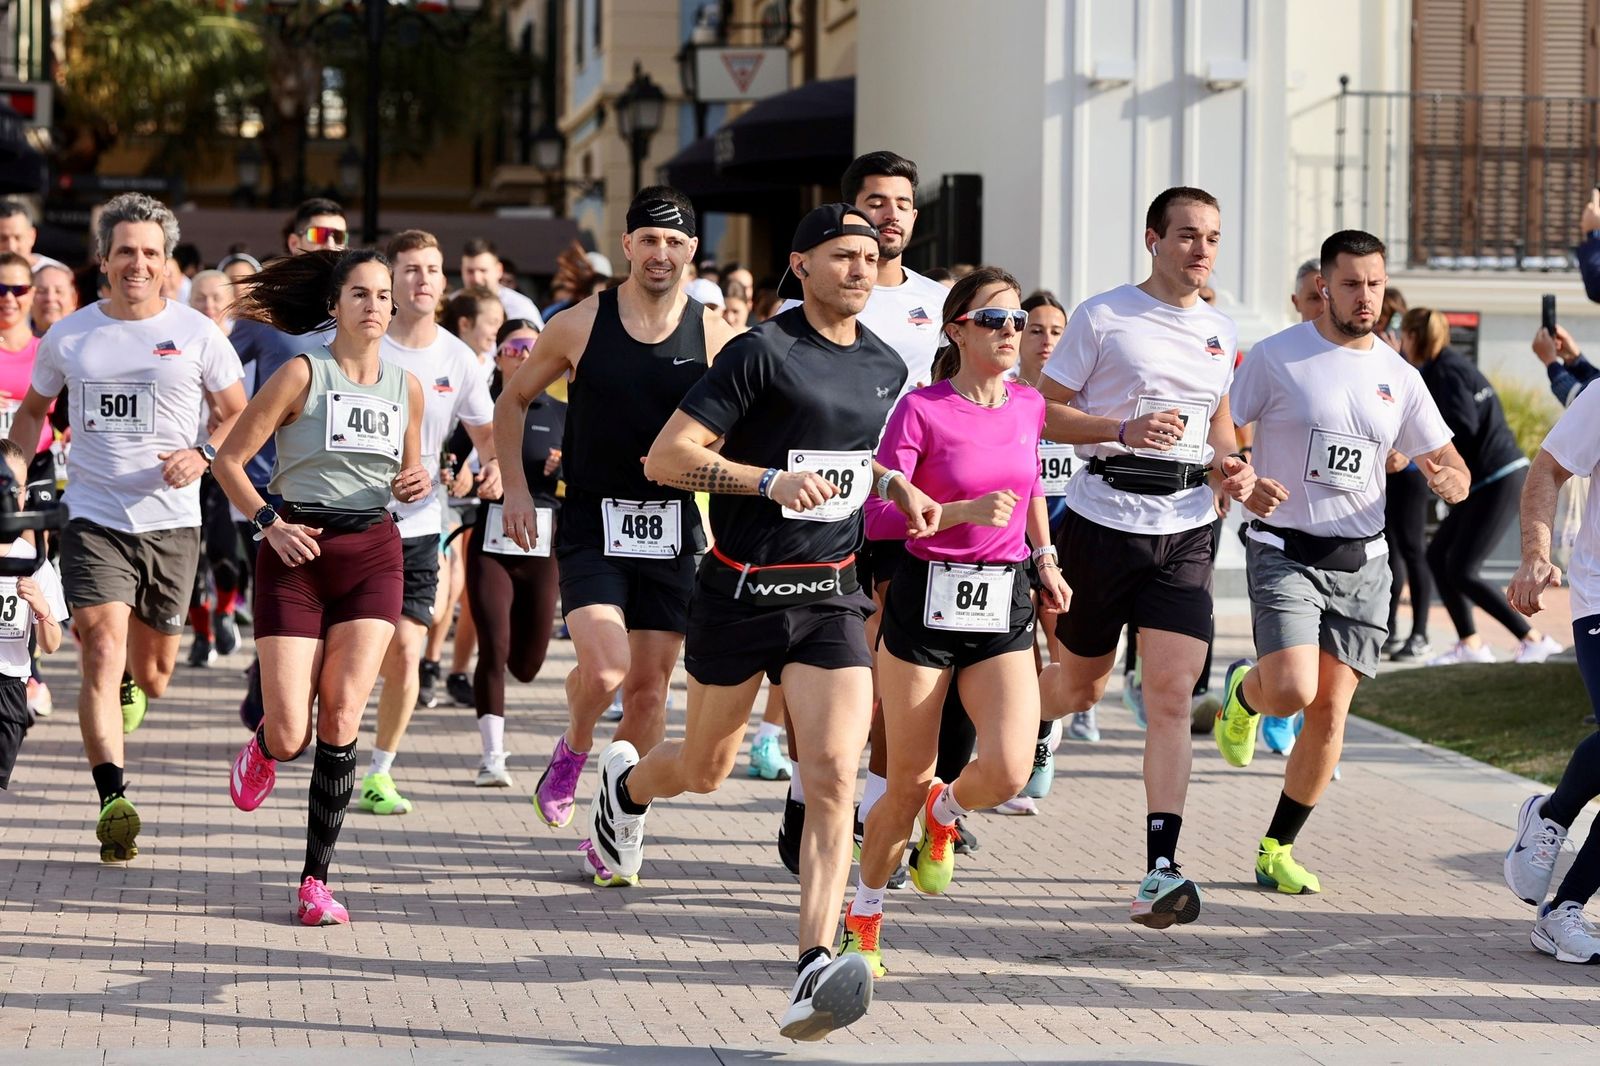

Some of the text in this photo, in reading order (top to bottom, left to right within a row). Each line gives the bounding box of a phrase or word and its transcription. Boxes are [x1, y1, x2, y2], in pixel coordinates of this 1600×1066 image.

[100, 393, 137, 418] 501
[347, 407, 390, 437] 408
[1327, 444, 1362, 473] 123
[621, 514, 663, 540] 488
[746, 579, 836, 596] WONG
[956, 580, 989, 610] 84
